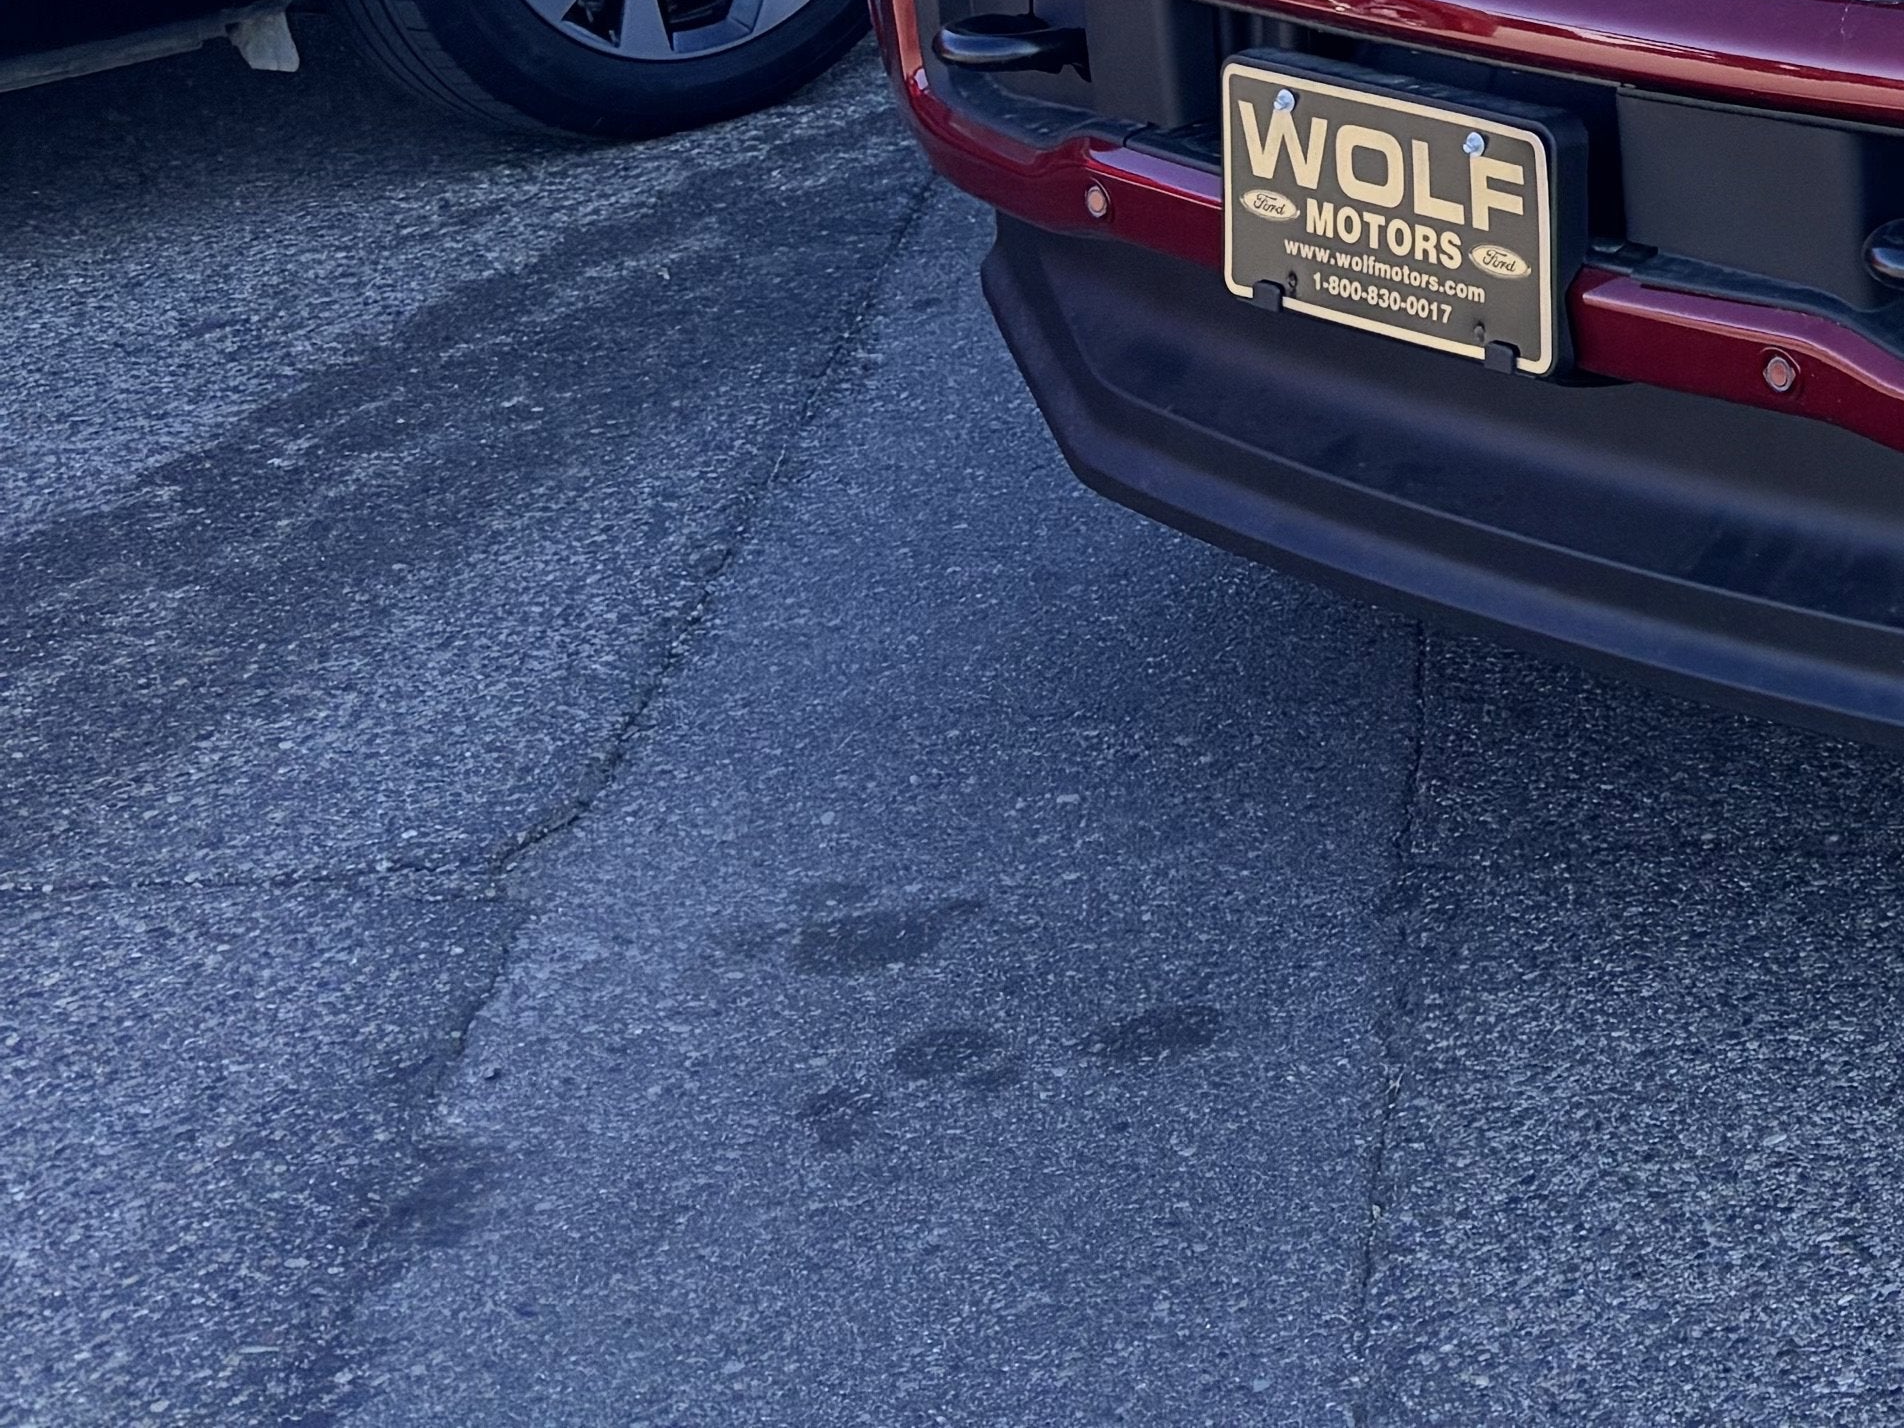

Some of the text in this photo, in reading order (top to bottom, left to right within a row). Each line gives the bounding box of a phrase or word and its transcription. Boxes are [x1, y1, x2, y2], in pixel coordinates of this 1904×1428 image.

[1237, 99, 1526, 232] WOLF
[1253, 193, 1286, 216] Ford
[1305, 197, 1464, 270] MOTORS
[1283, 238, 1486, 304] www.wolfmotors.com
[1482, 249, 1516, 273] Ford
[1312, 271, 1454, 325] 1-800-830-0017
